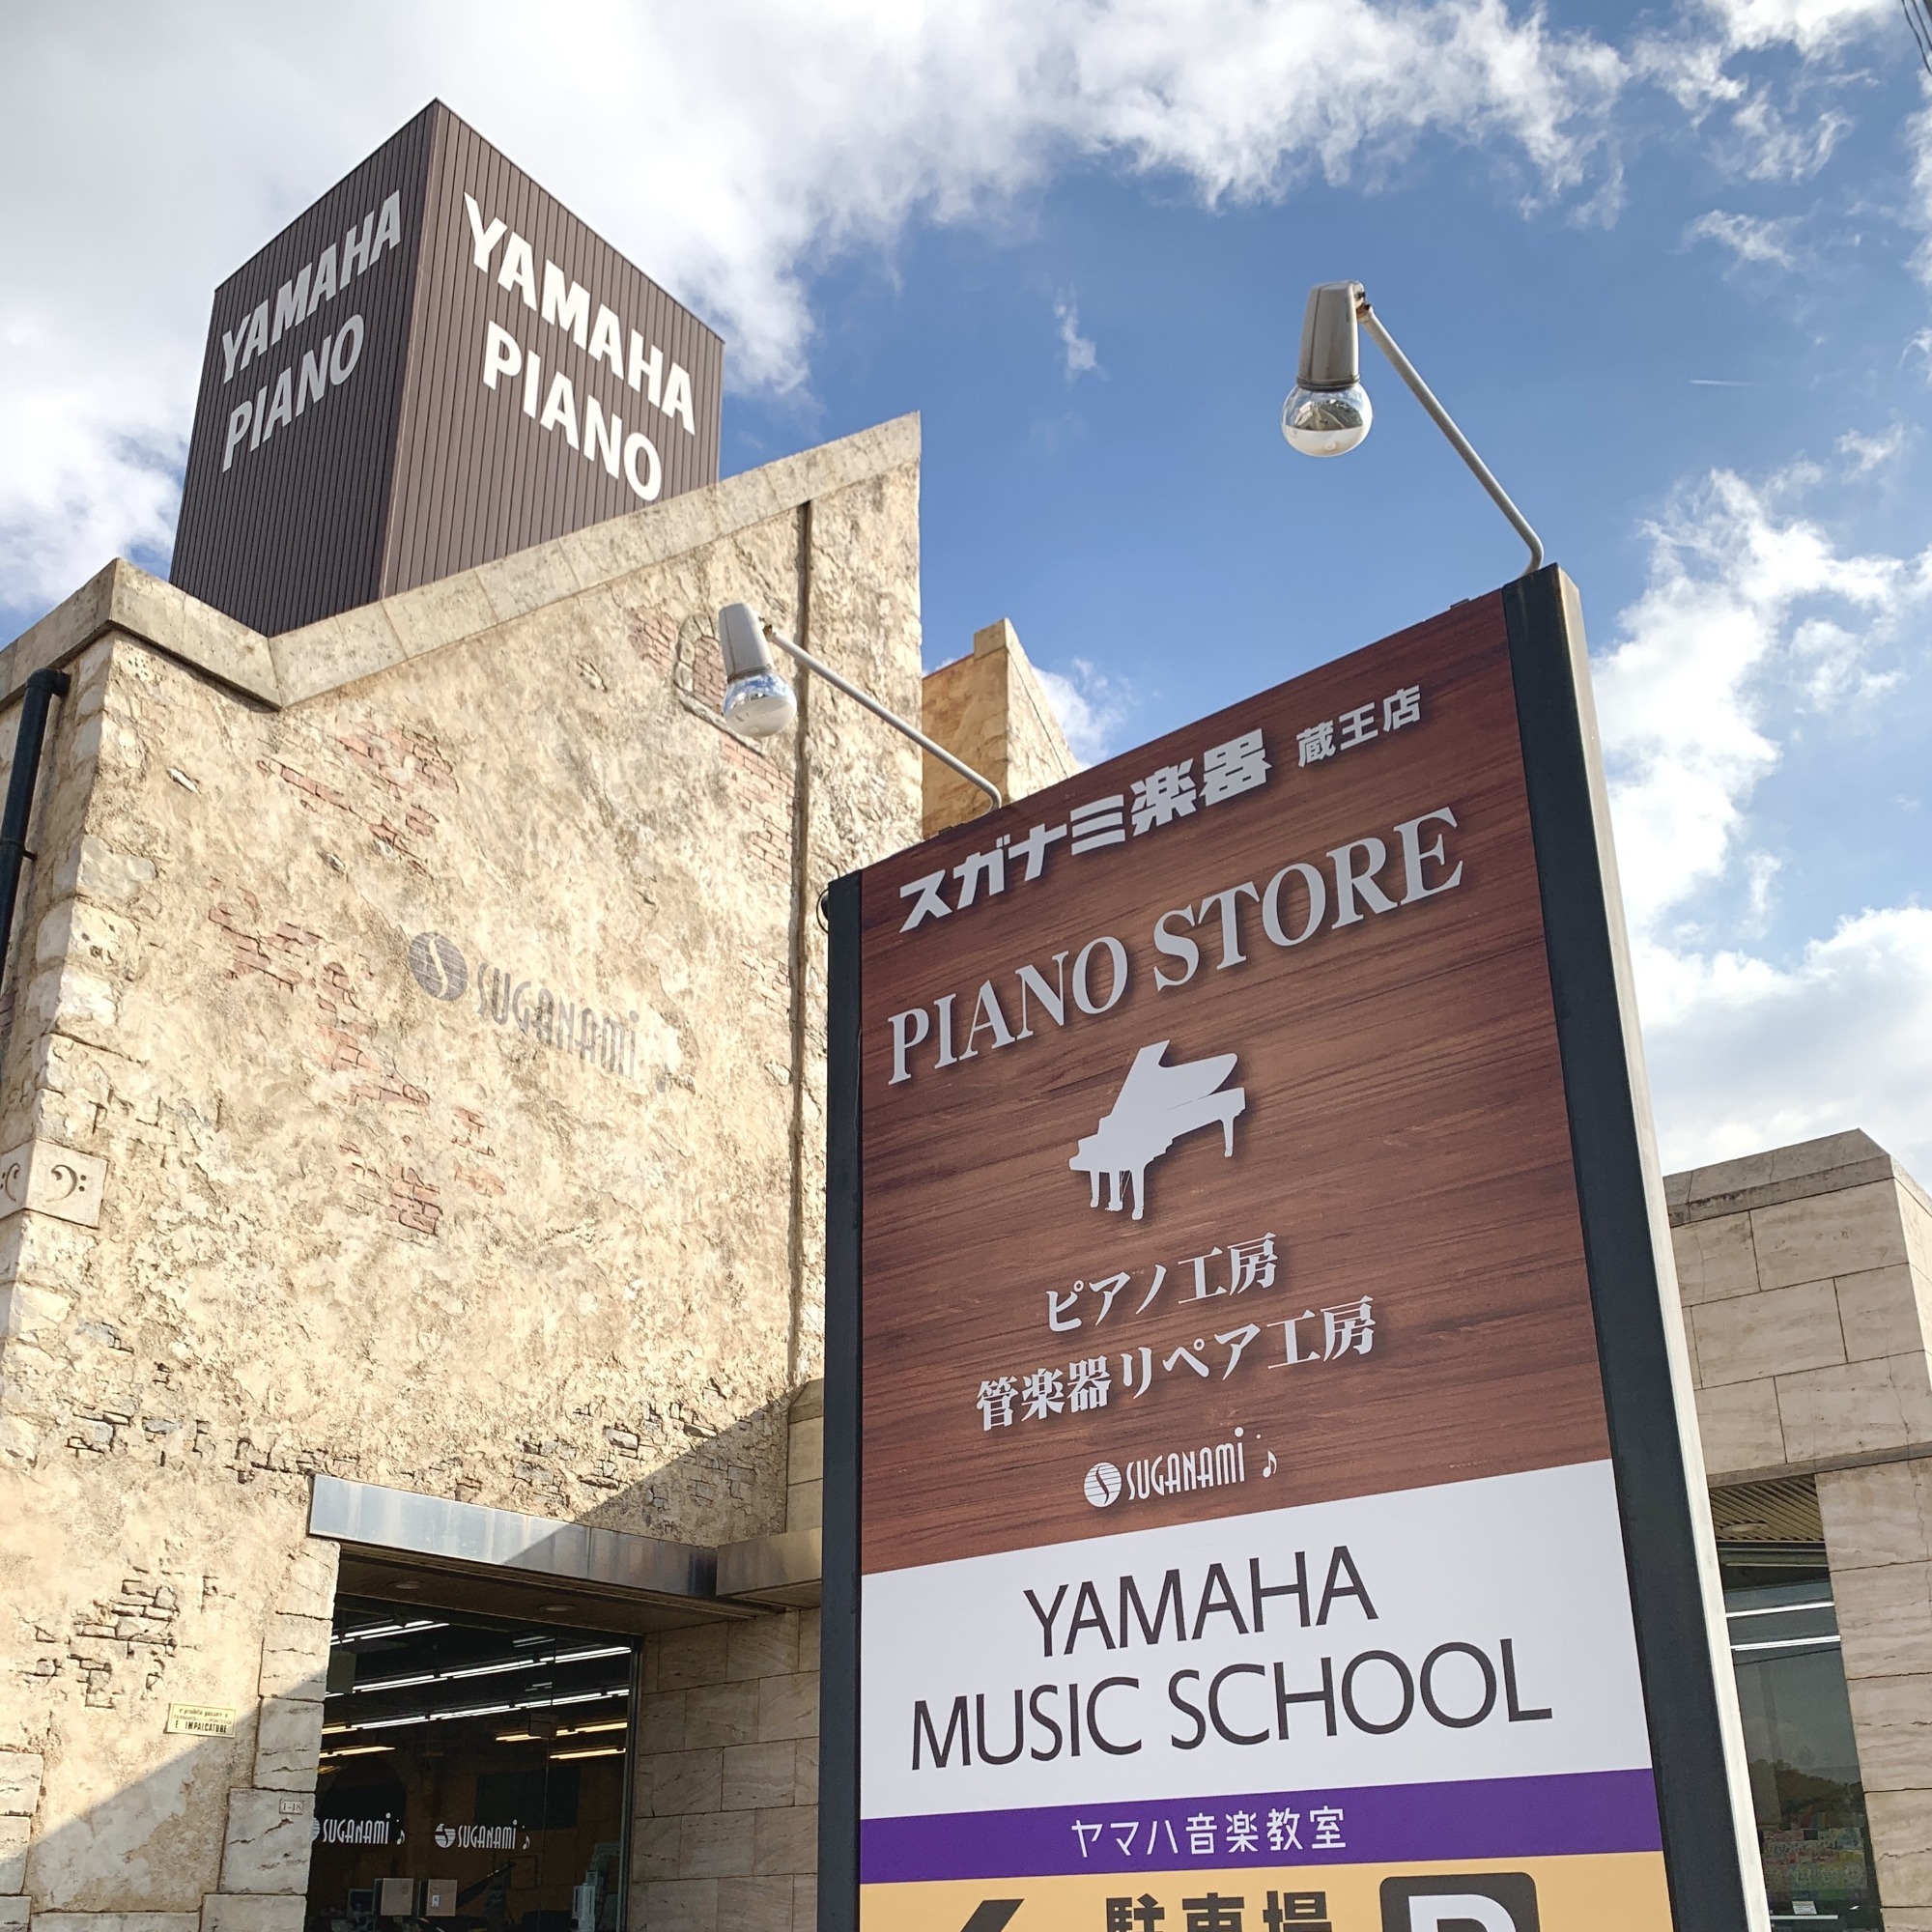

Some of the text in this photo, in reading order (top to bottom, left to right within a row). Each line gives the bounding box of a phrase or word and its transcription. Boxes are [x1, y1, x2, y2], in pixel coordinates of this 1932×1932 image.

[222, 189, 401, 384] YAMAHA
[465, 192, 696, 436] YAMAHA
[222, 315, 364, 473] PIANO
[484, 321, 662, 501] PIANO
[899, 685, 1420, 933] スガナミ楽器 蔵王店
[888, 807, 1463, 1086] PIANO STORE
[1046, 1232, 1278, 1332] ピアノ工房
[976, 1294, 1377, 1432] 管楽器リペア工房
[1023, 1545, 1379, 1658] YAMAHA
[912, 1637, 1553, 1771] MUSIC SCHOOL
[1071, 1804, 1347, 1858] ヤマハ音楽教室
